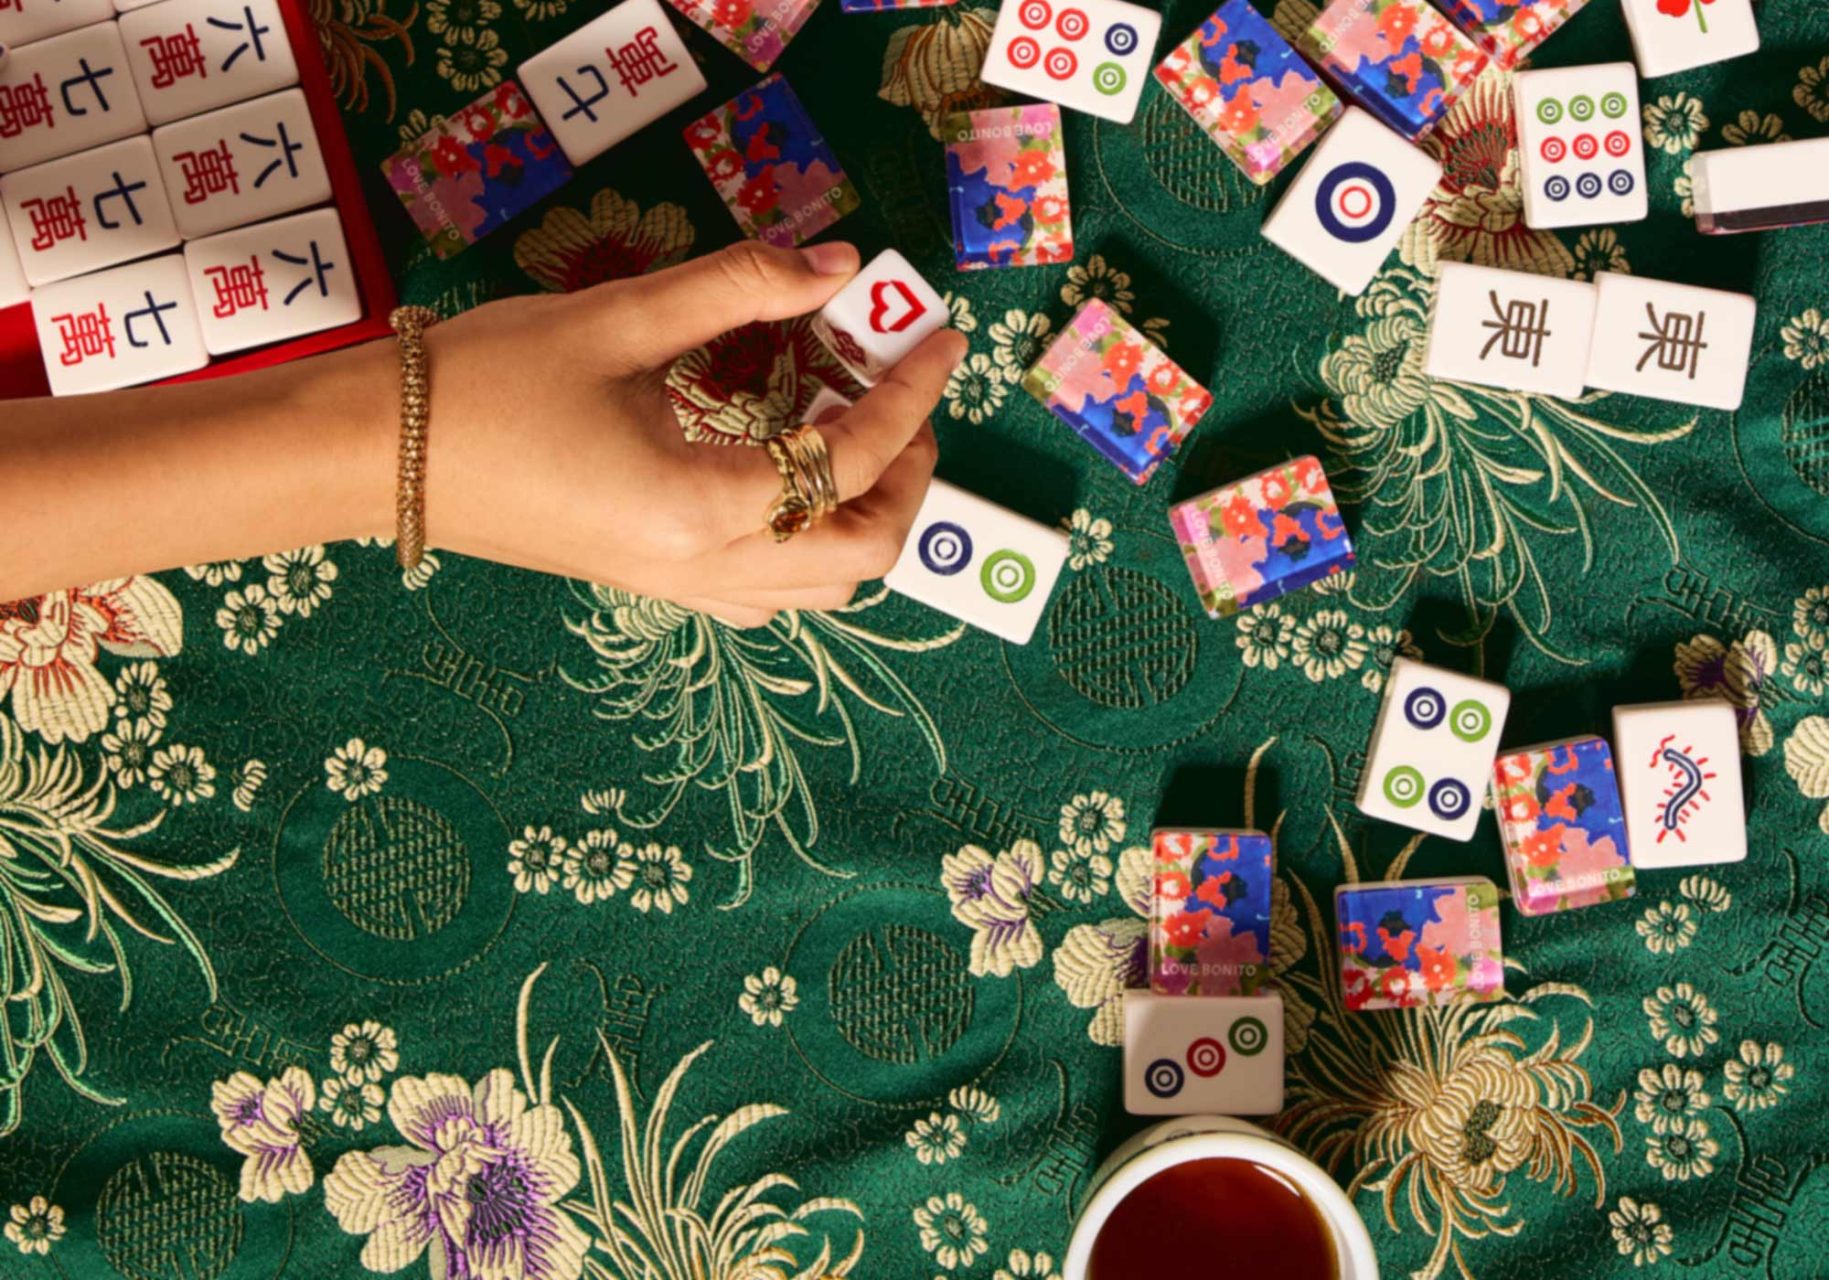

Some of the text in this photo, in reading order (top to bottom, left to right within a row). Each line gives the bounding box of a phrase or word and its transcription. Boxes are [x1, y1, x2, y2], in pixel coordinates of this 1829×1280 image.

[747, 20, 777, 53] LOVE
[958, 121, 1052, 141] LOVE BONITO
[402, 159, 459, 240] LOVE BONITO
[794, 187, 841, 220] BONITO
[1479, 290, 1552, 367] 東
[1635, 302, 1708, 379] 東
[1161, 963, 1257, 977] LOVE BONITO
